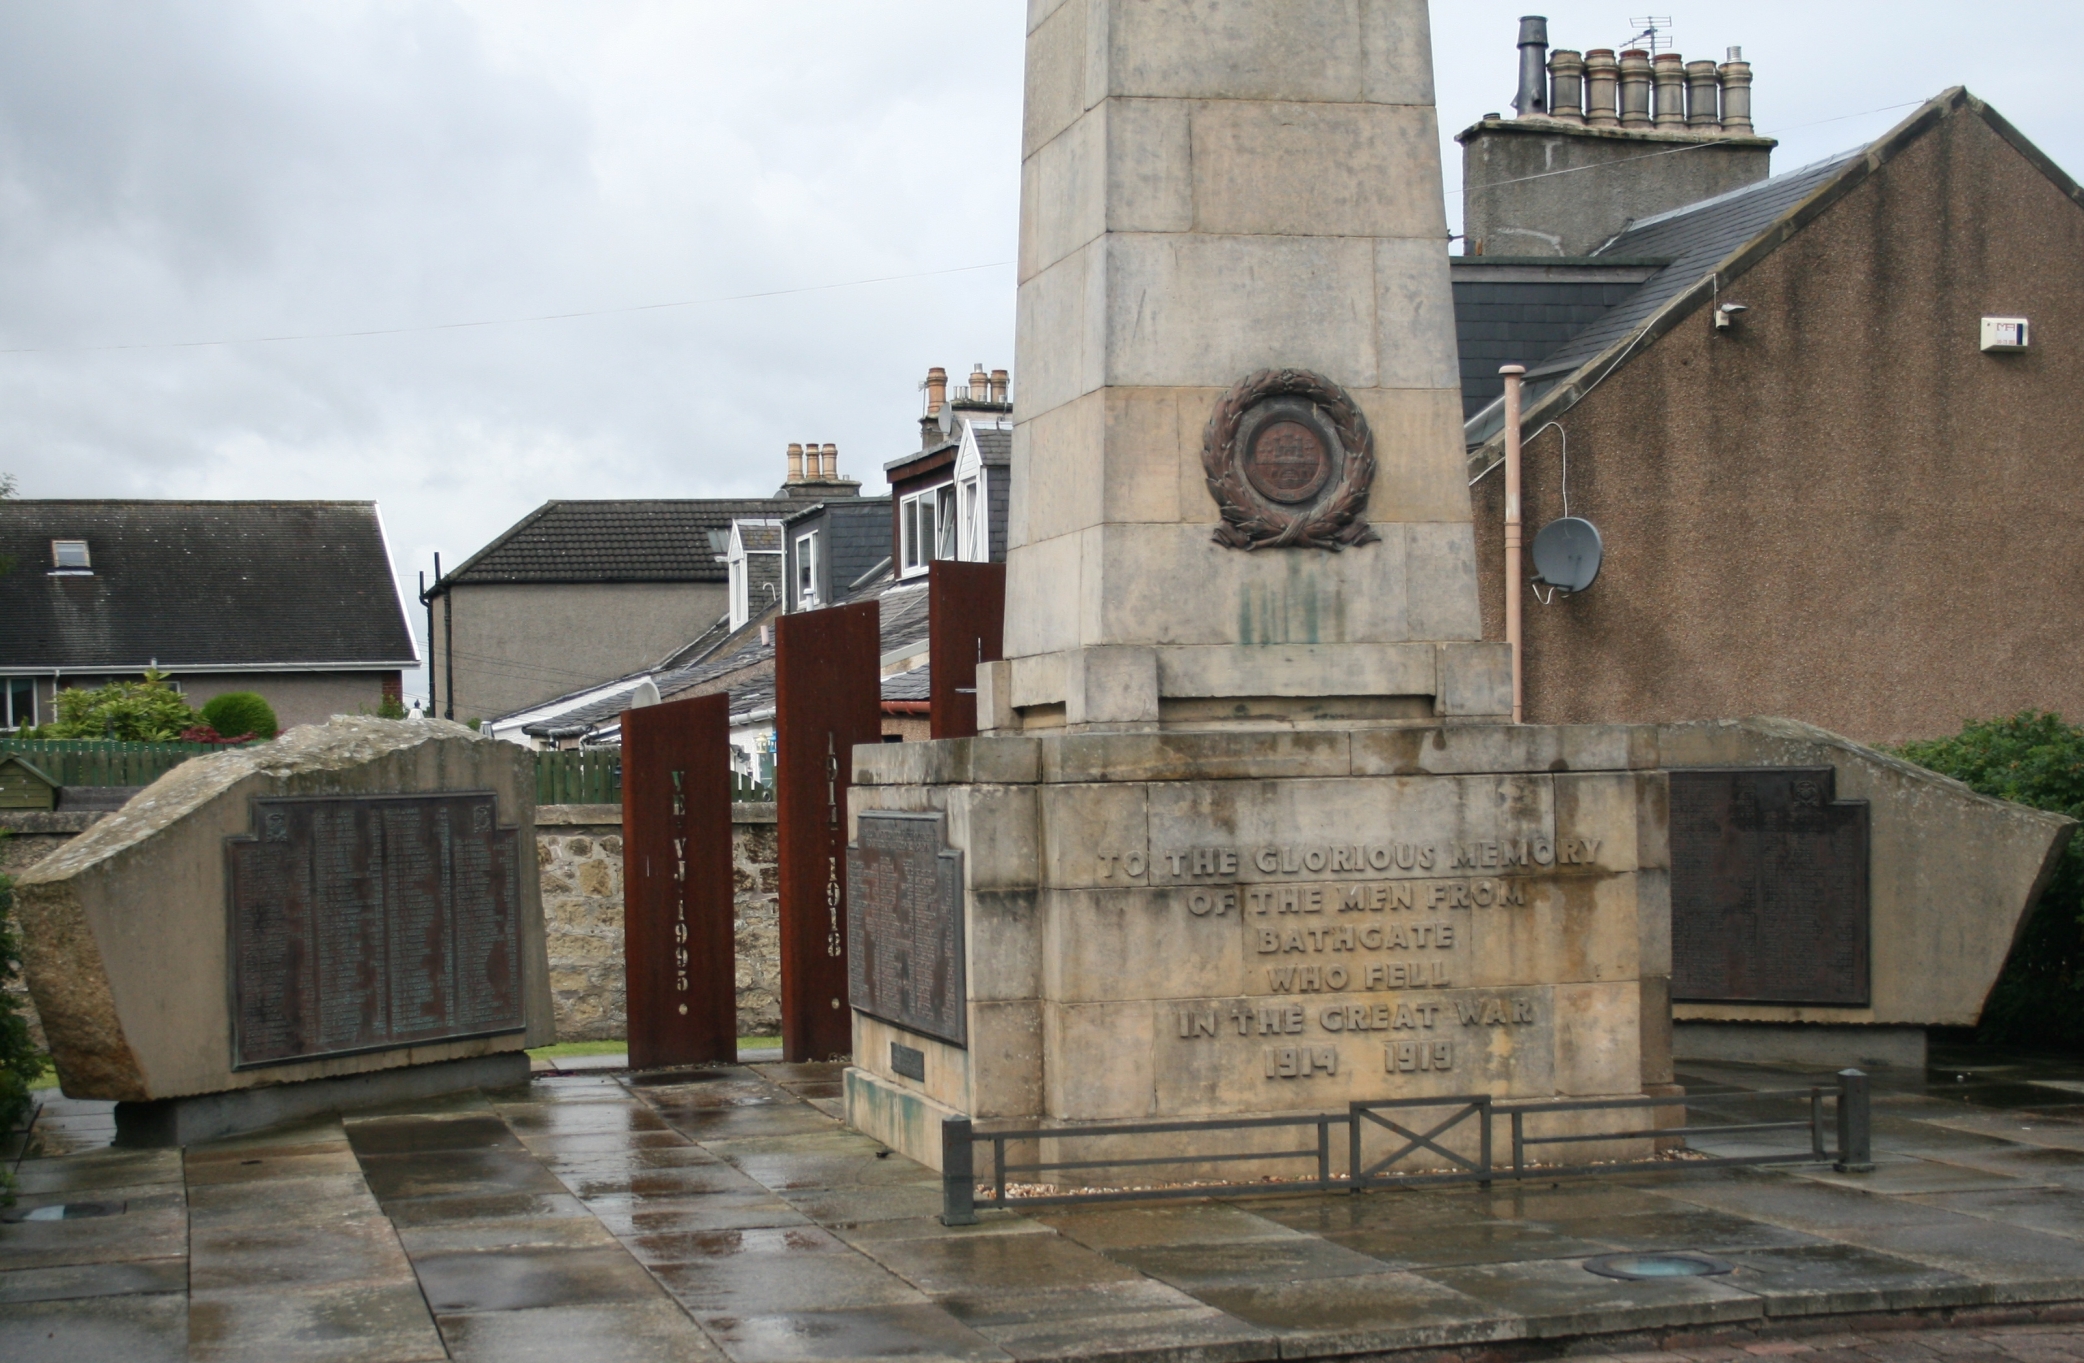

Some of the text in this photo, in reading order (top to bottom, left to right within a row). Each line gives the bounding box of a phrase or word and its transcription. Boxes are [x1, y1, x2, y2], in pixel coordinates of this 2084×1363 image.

[1099, 837, 1601, 878] TO THE GLORIOUS MEMORY
[1187, 876, 1525, 916] OF THE MEN FROM
[1257, 921, 1454, 954] BATHGATE
[1267, 960, 1450, 992] WHO FELL
[1179, 998, 1533, 1039] IN THE GREAT WAR
[1264, 1040, 1452, 1079] 1914 1919
